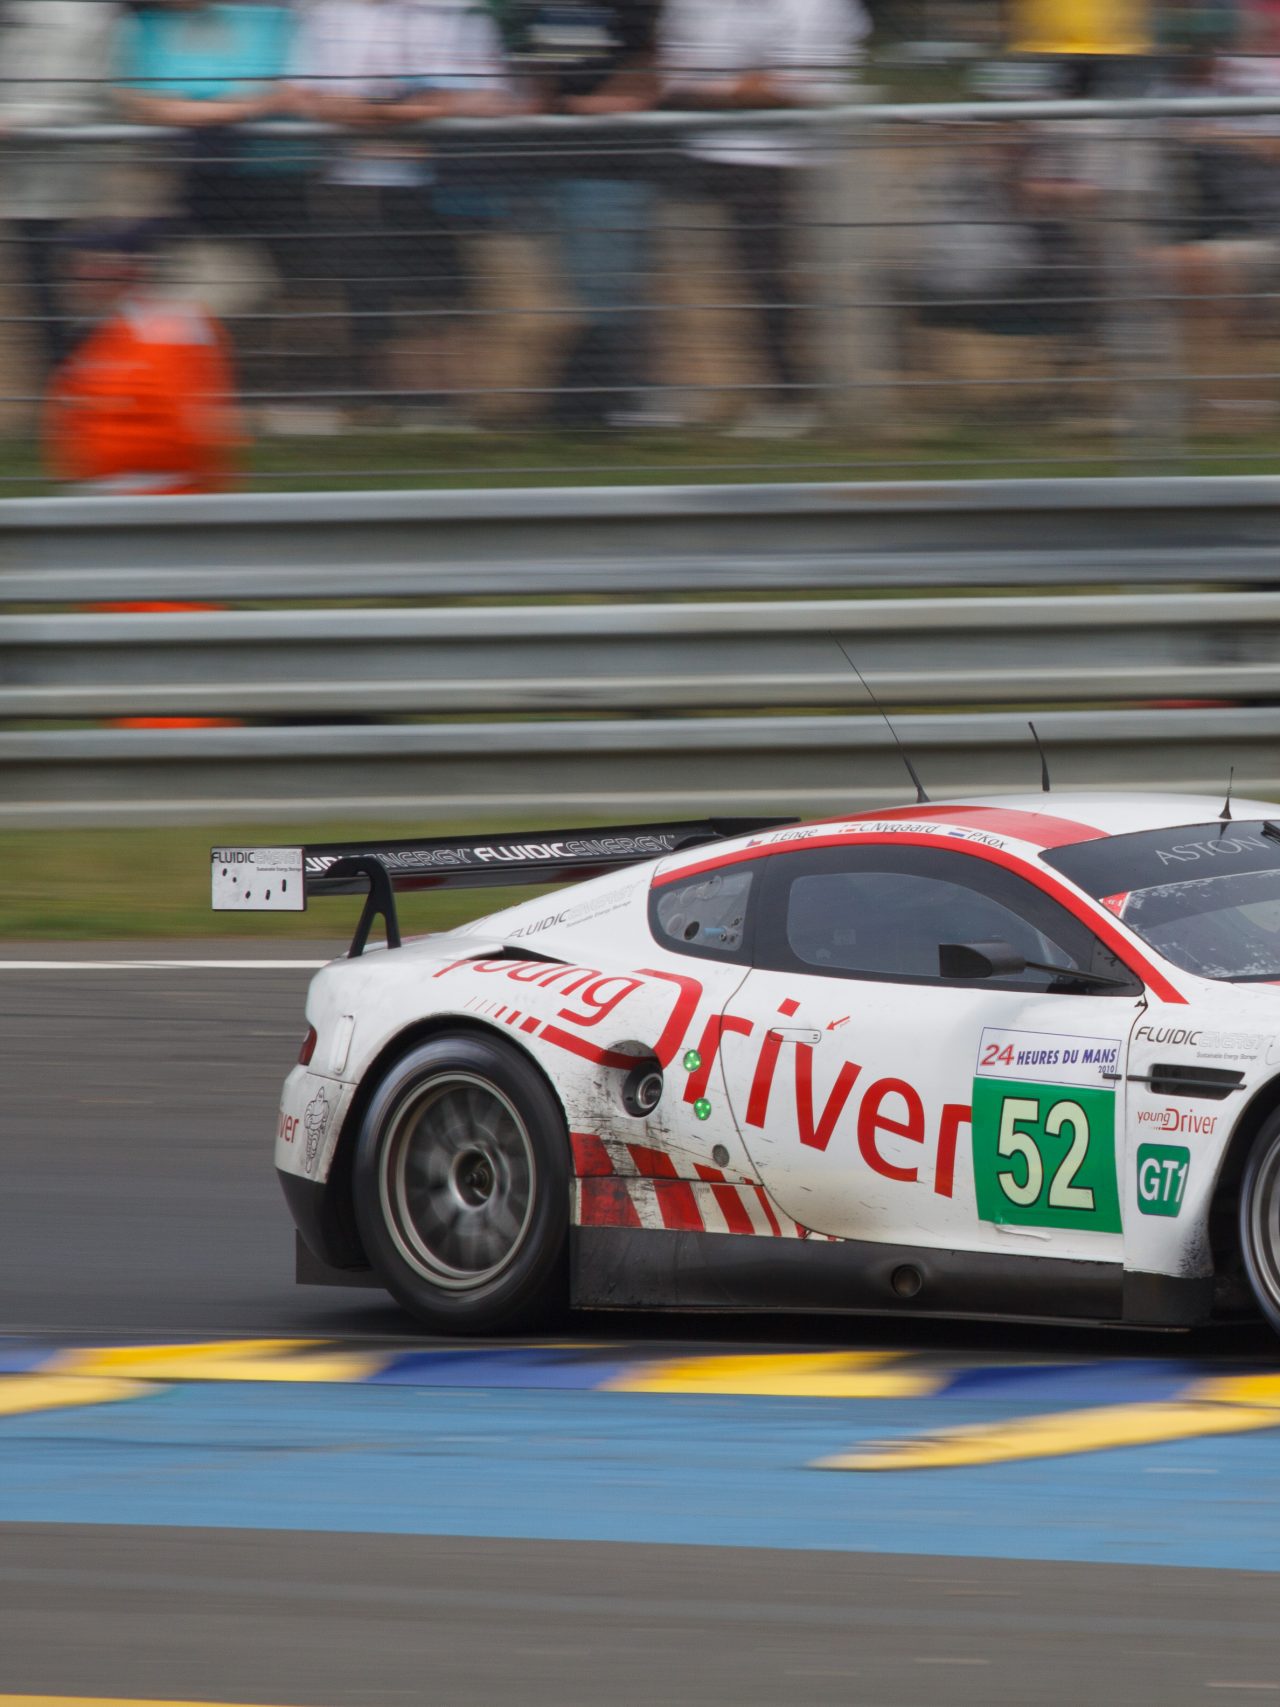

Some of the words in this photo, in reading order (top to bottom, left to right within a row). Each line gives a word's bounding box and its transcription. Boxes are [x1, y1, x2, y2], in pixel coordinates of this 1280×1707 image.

[1154, 835, 1271, 865] ASTON
[980, 1043, 1015, 1067] 24
[1016, 1050, 1060, 1066] HEURES
[1062, 1050, 1079, 1064] DU
[1081, 1048, 1118, 1064] MANS
[1098, 1065, 1116, 1075] 2010
[996, 1095, 1096, 1211] 52
[1138, 1157, 1189, 1203] GT1
